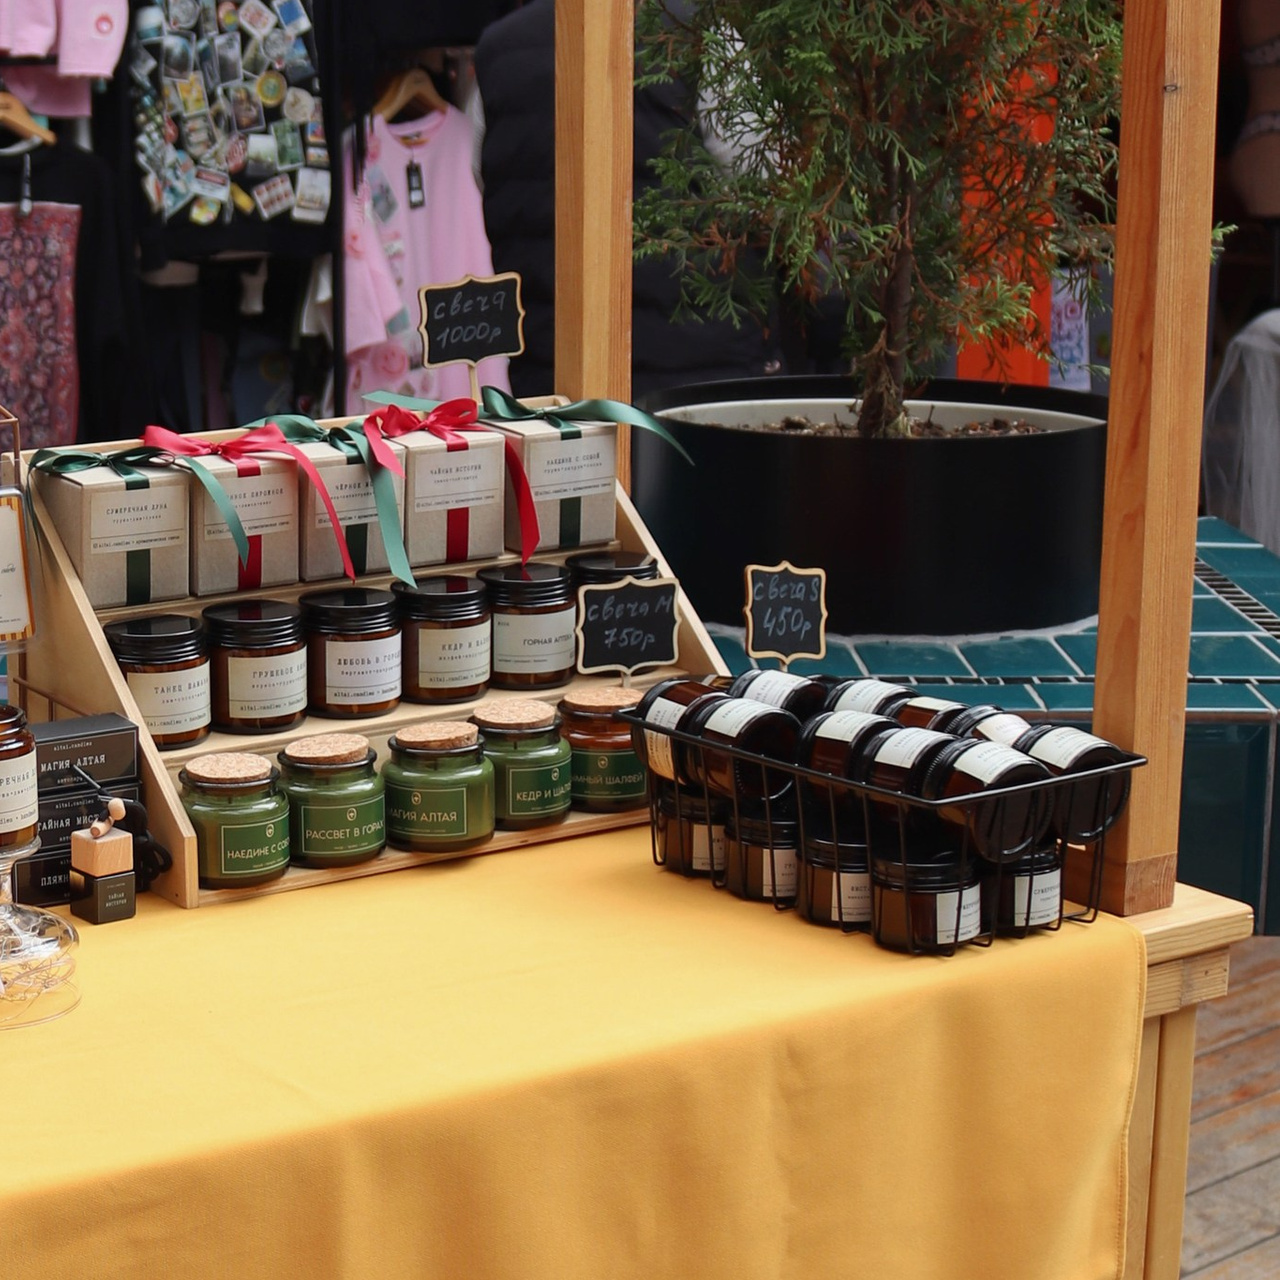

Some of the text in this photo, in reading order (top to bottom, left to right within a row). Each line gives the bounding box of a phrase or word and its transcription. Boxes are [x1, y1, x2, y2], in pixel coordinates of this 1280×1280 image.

[433, 291, 506, 319] свеча
[436, 321, 502, 349] 1000р
[762, 606, 812, 640] 450р
[441, 642, 464, 652] КЕДР
[523, 637, 553, 646] ГОРНАЯ
[154, 685, 183, 695] ТАНЕЦ
[40, 754, 106, 773] МАГИЯ АЛТАЯ
[605, 772, 643, 785] ШАЛФЕЙ
[516, 791, 542, 801] КЕДР
[391, 807, 457, 822] АГИЯ АЛТАЯ
[305, 828, 351, 839] РАССВЕТ
[353, 827, 360, 837] В
[227, 846, 270, 859] НАЕДИНЕ
[270, 843, 277, 853] С
[40, 873, 70, 887] ПЛЯЖН
